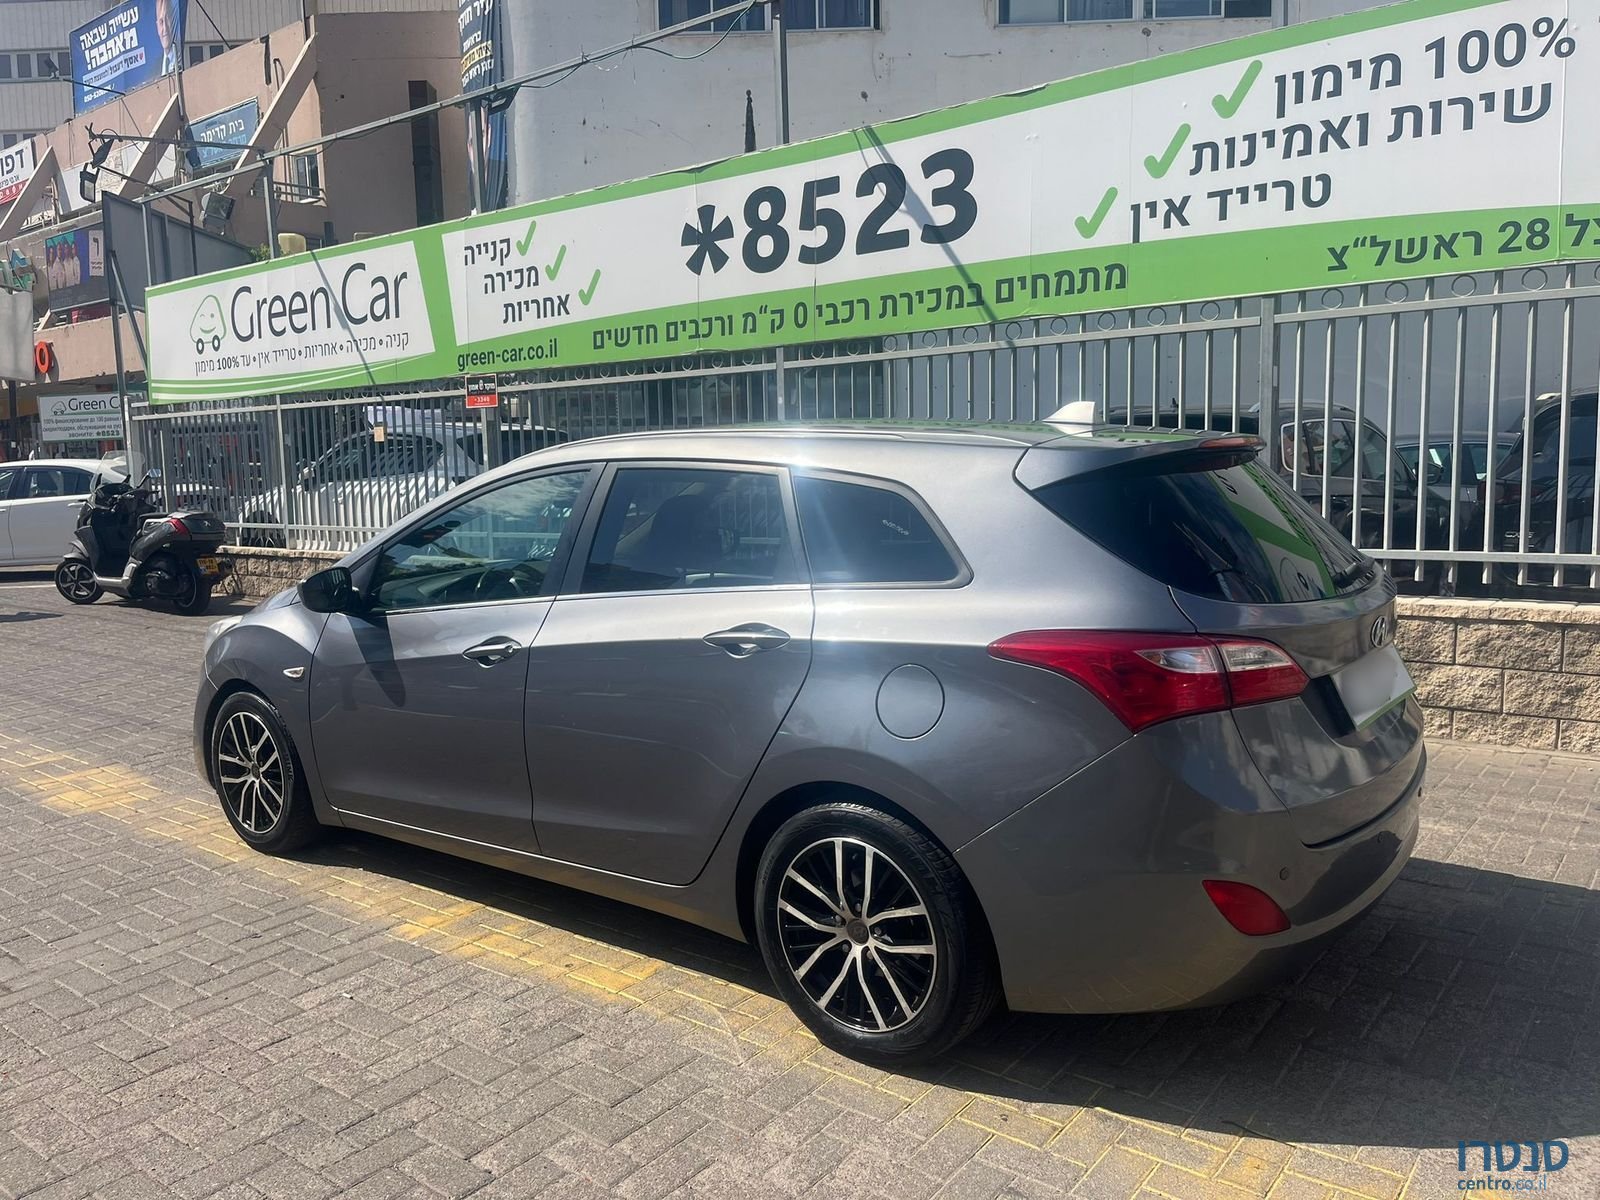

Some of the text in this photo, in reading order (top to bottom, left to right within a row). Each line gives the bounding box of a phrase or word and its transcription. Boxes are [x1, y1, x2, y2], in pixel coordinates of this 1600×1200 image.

[79, 6, 139, 50] עשייה שבאה
[84, 26, 139, 71] מאהבה!
[1274, 16, 1577, 119] 100% מימון
[228, 119, 245, 135] בית
[1188, 81, 1553, 177] שירות ואמינות
[1129, 172, 1333, 244] טרייד אין
[463, 237, 511, 267] קנייה
[1497, 217, 1551, 254] 28
[483, 265, 540, 295] מכירה
[995, 262, 1128, 304] מתמחים
[230, 262, 408, 342] Green Car
[502, 293, 571, 324] אחריות
[793, 301, 808, 329] 0
[815, 297, 870, 326] רכבי
[878, 282, 985, 320] במכירת
[592, 323, 658, 350] חדשים
[665, 313, 733, 343] ורכבים
[194, 332, 409, 376] קניה מכירה אחריות טרייד אין עד 100% מימון
[457, 337, 558, 372] green-car.co.il
[68, 398, 106, 411] Green
